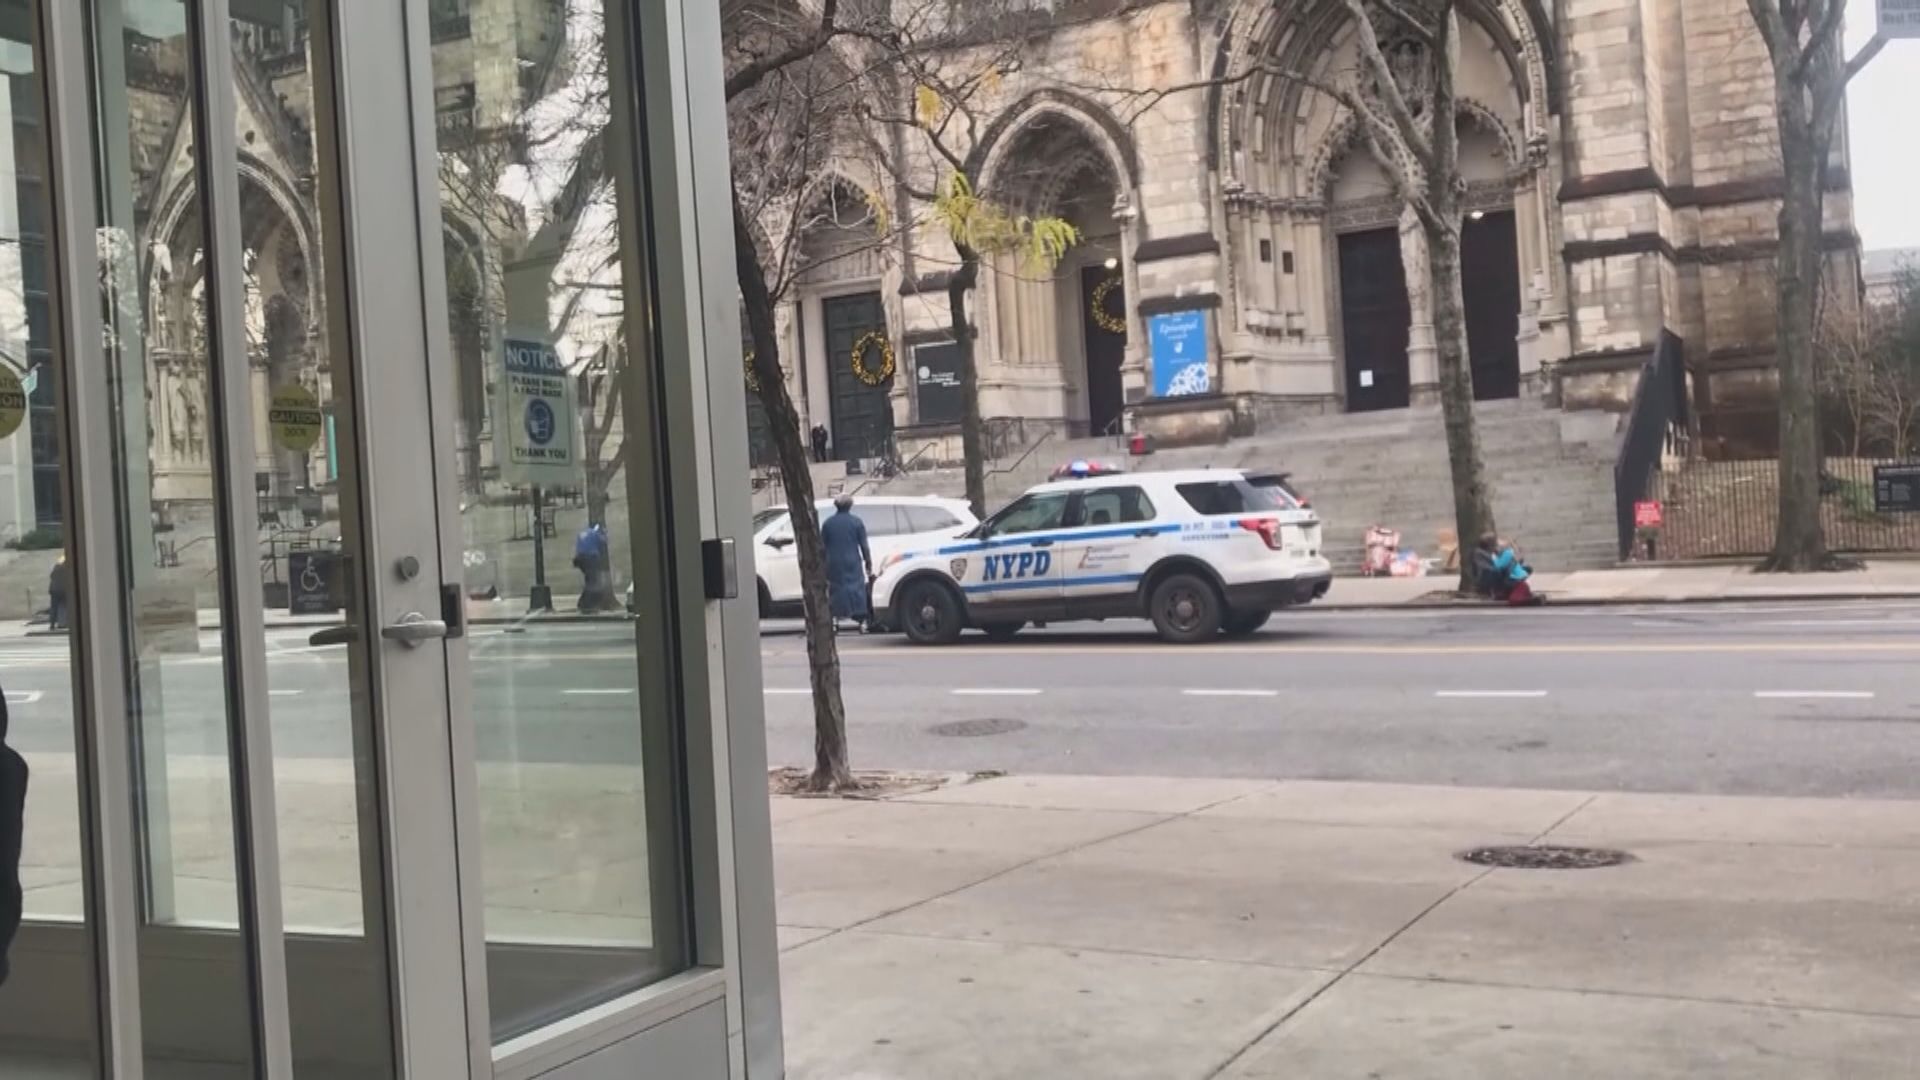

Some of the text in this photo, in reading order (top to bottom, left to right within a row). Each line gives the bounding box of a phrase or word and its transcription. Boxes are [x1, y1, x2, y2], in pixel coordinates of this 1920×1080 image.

[515, 447, 566, 460] THANK YOU
[982, 550, 1051, 581] NYPD
